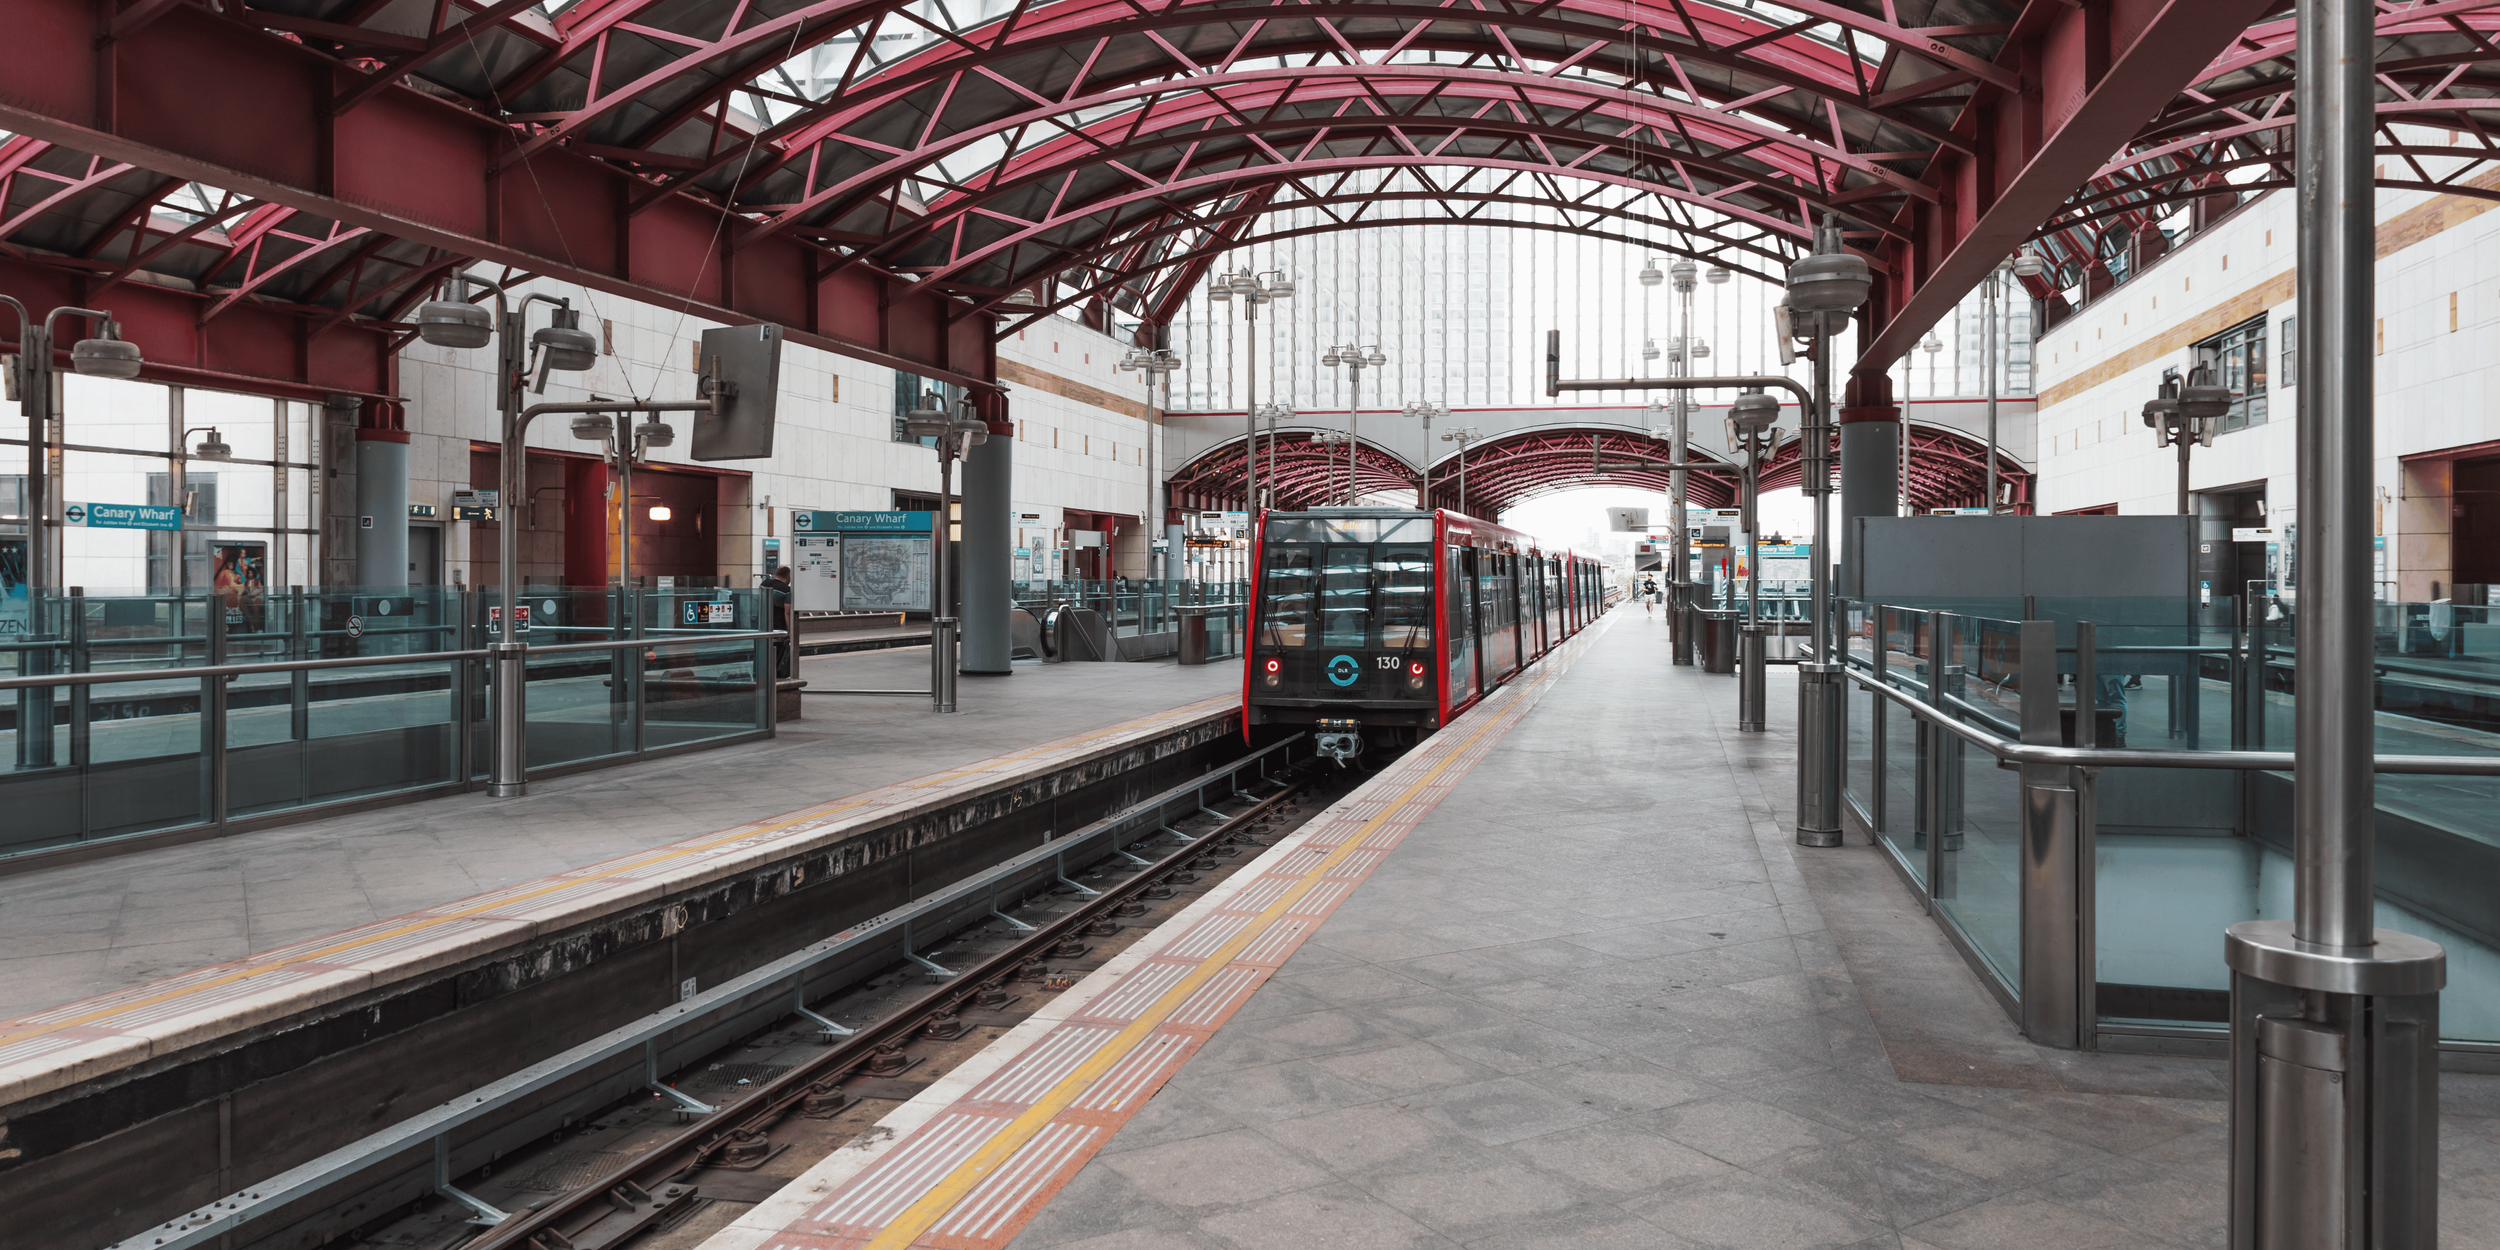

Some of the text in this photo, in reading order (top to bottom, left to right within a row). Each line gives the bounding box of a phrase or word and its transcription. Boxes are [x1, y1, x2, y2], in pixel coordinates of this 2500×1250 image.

[93, 506, 175, 521] Canary Wharf
[836, 513, 907, 525] Canary Wharf
[1332, 520, 1368, 531] Stratford
[1376, 656, 1400, 670] 130
